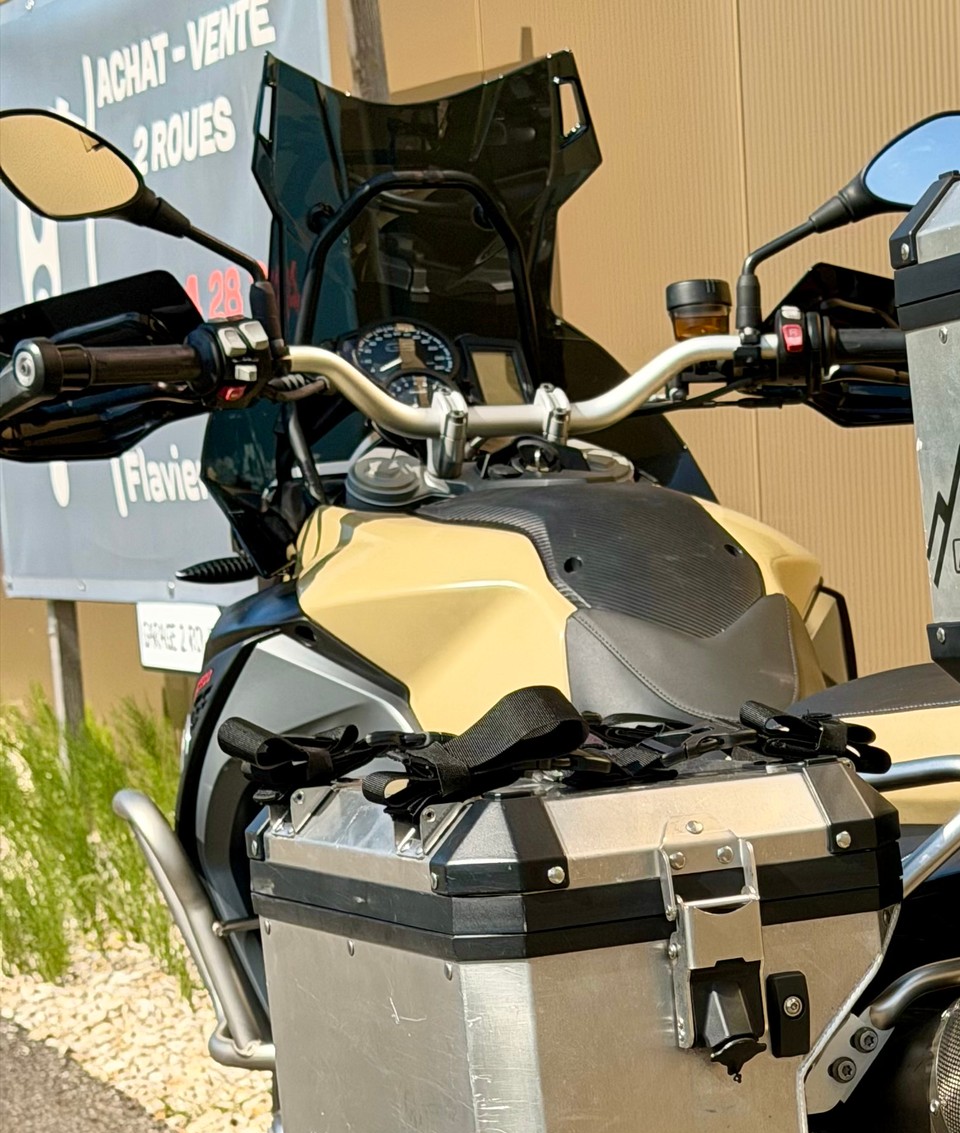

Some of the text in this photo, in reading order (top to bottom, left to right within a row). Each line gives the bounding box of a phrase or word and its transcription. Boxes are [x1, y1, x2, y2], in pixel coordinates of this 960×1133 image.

[97, 32, 169, 108] ACHAT
[187, 0, 276, 71] VENTE
[133, 96, 236, 176] 2 ROUES
[208, 265, 244, 318] 28
